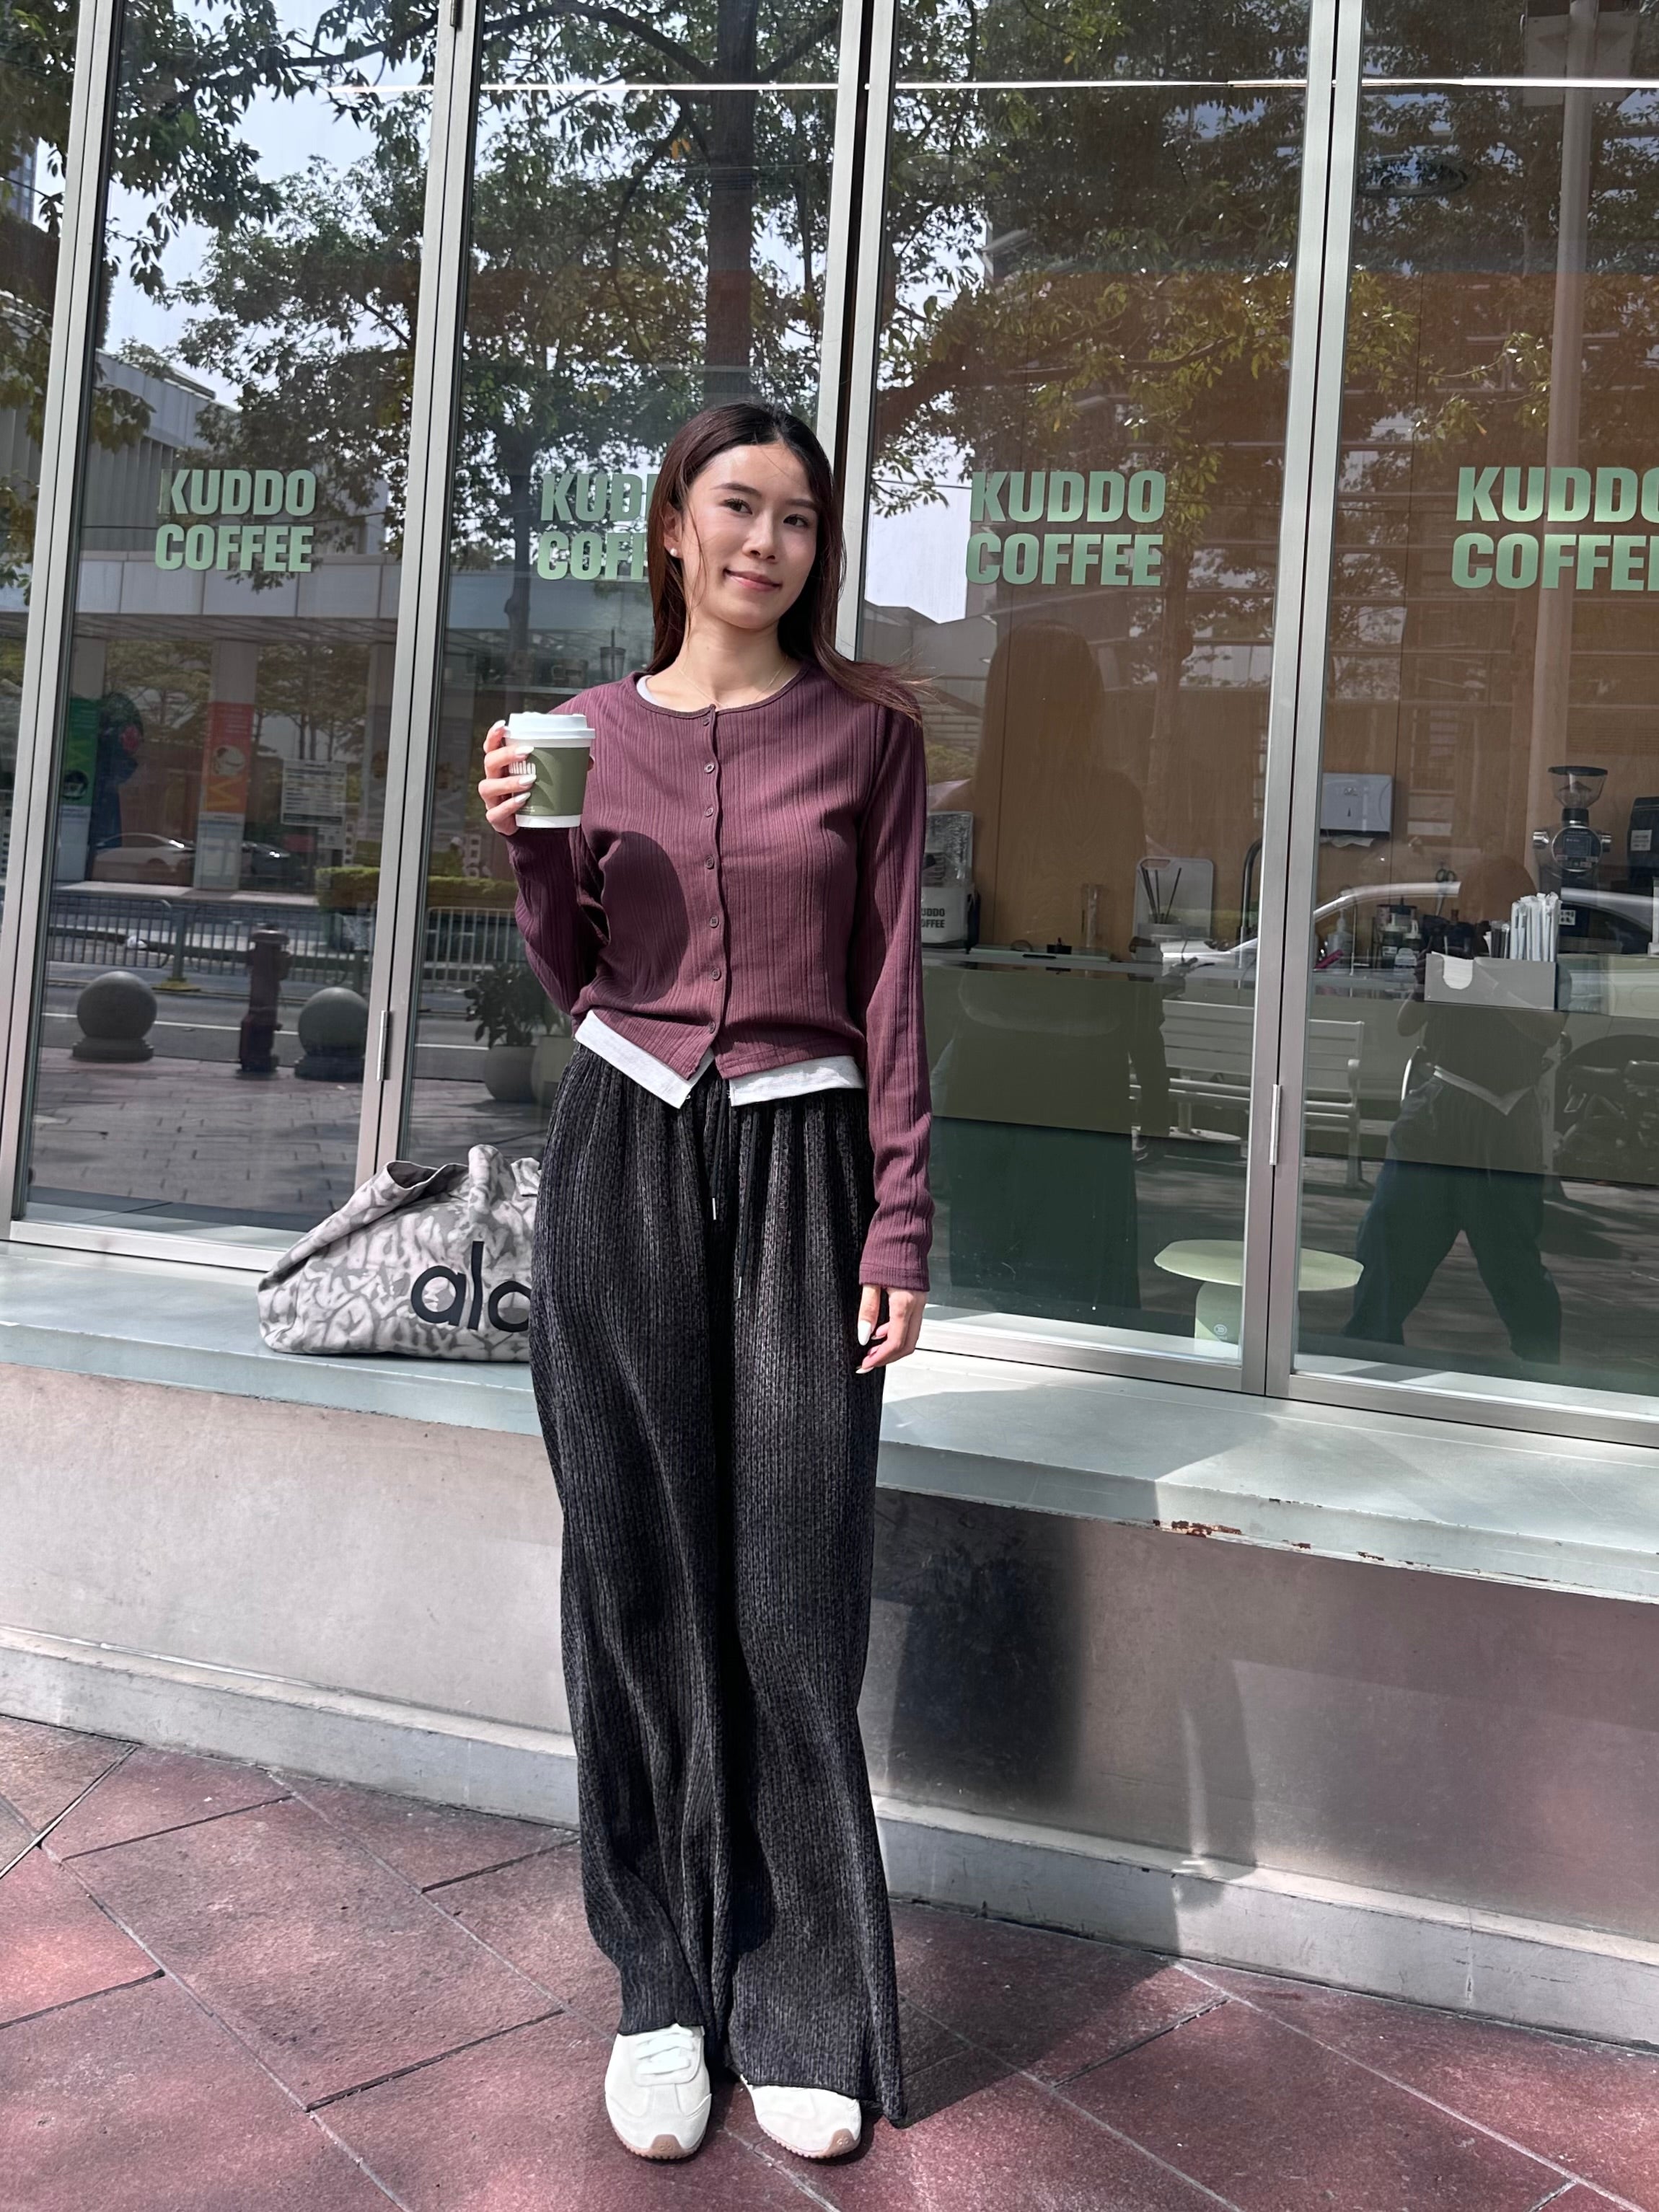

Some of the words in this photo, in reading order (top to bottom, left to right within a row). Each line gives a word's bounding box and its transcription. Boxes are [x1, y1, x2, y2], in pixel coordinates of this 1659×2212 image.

[158, 469, 316, 516] KUDDO
[541, 473, 660, 521] KUD
[970, 470, 1166, 523] KUDDO
[155, 524, 314, 572] COFFEE
[966, 533, 1163, 586] COFFEE
[921, 907, 946, 917] UDDO
[921, 919, 946, 928] OFFEE
